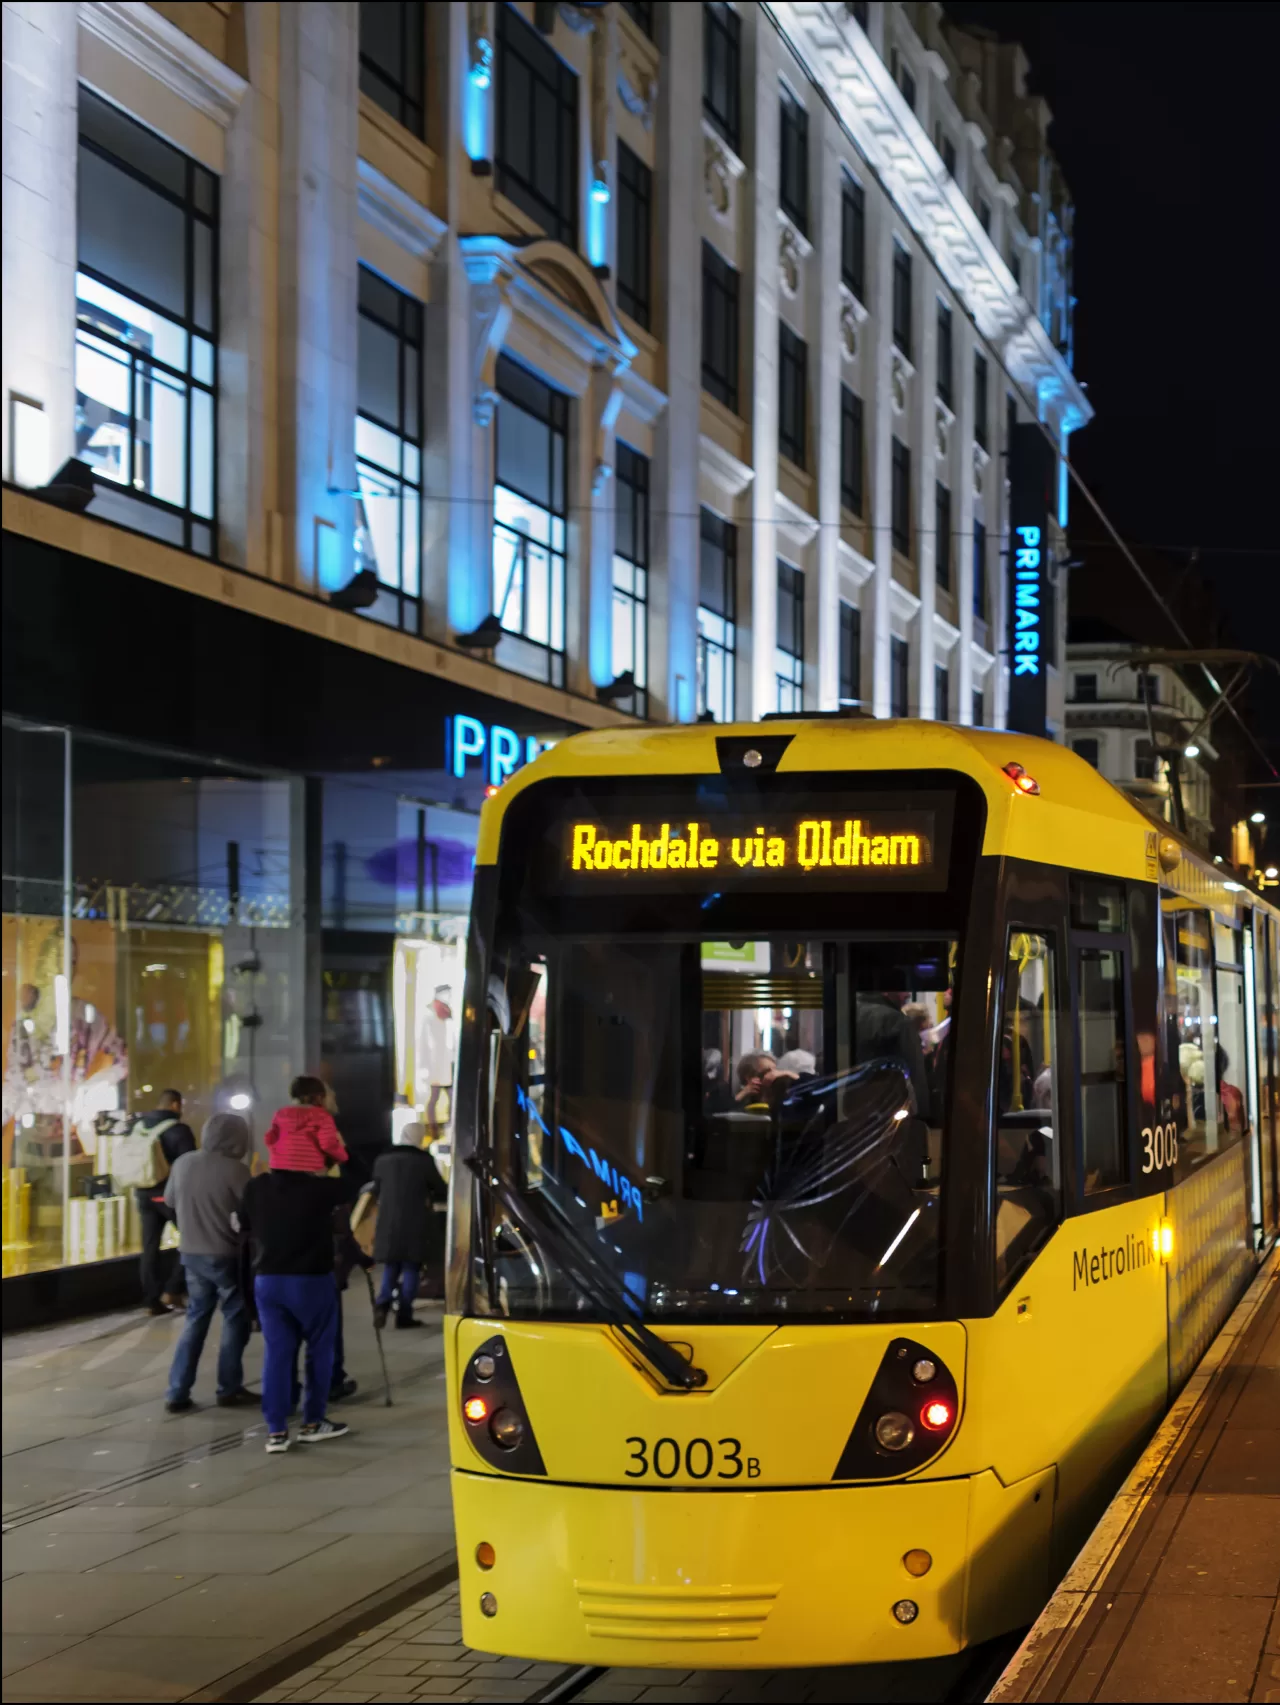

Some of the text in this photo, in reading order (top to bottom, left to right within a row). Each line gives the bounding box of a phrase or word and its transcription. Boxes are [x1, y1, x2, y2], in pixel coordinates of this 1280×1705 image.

[1014, 526, 1041, 676] PRIMARK
[572, 820, 919, 870] Rochdale via Oldham
[1141, 1121, 1178, 1174] 3003
